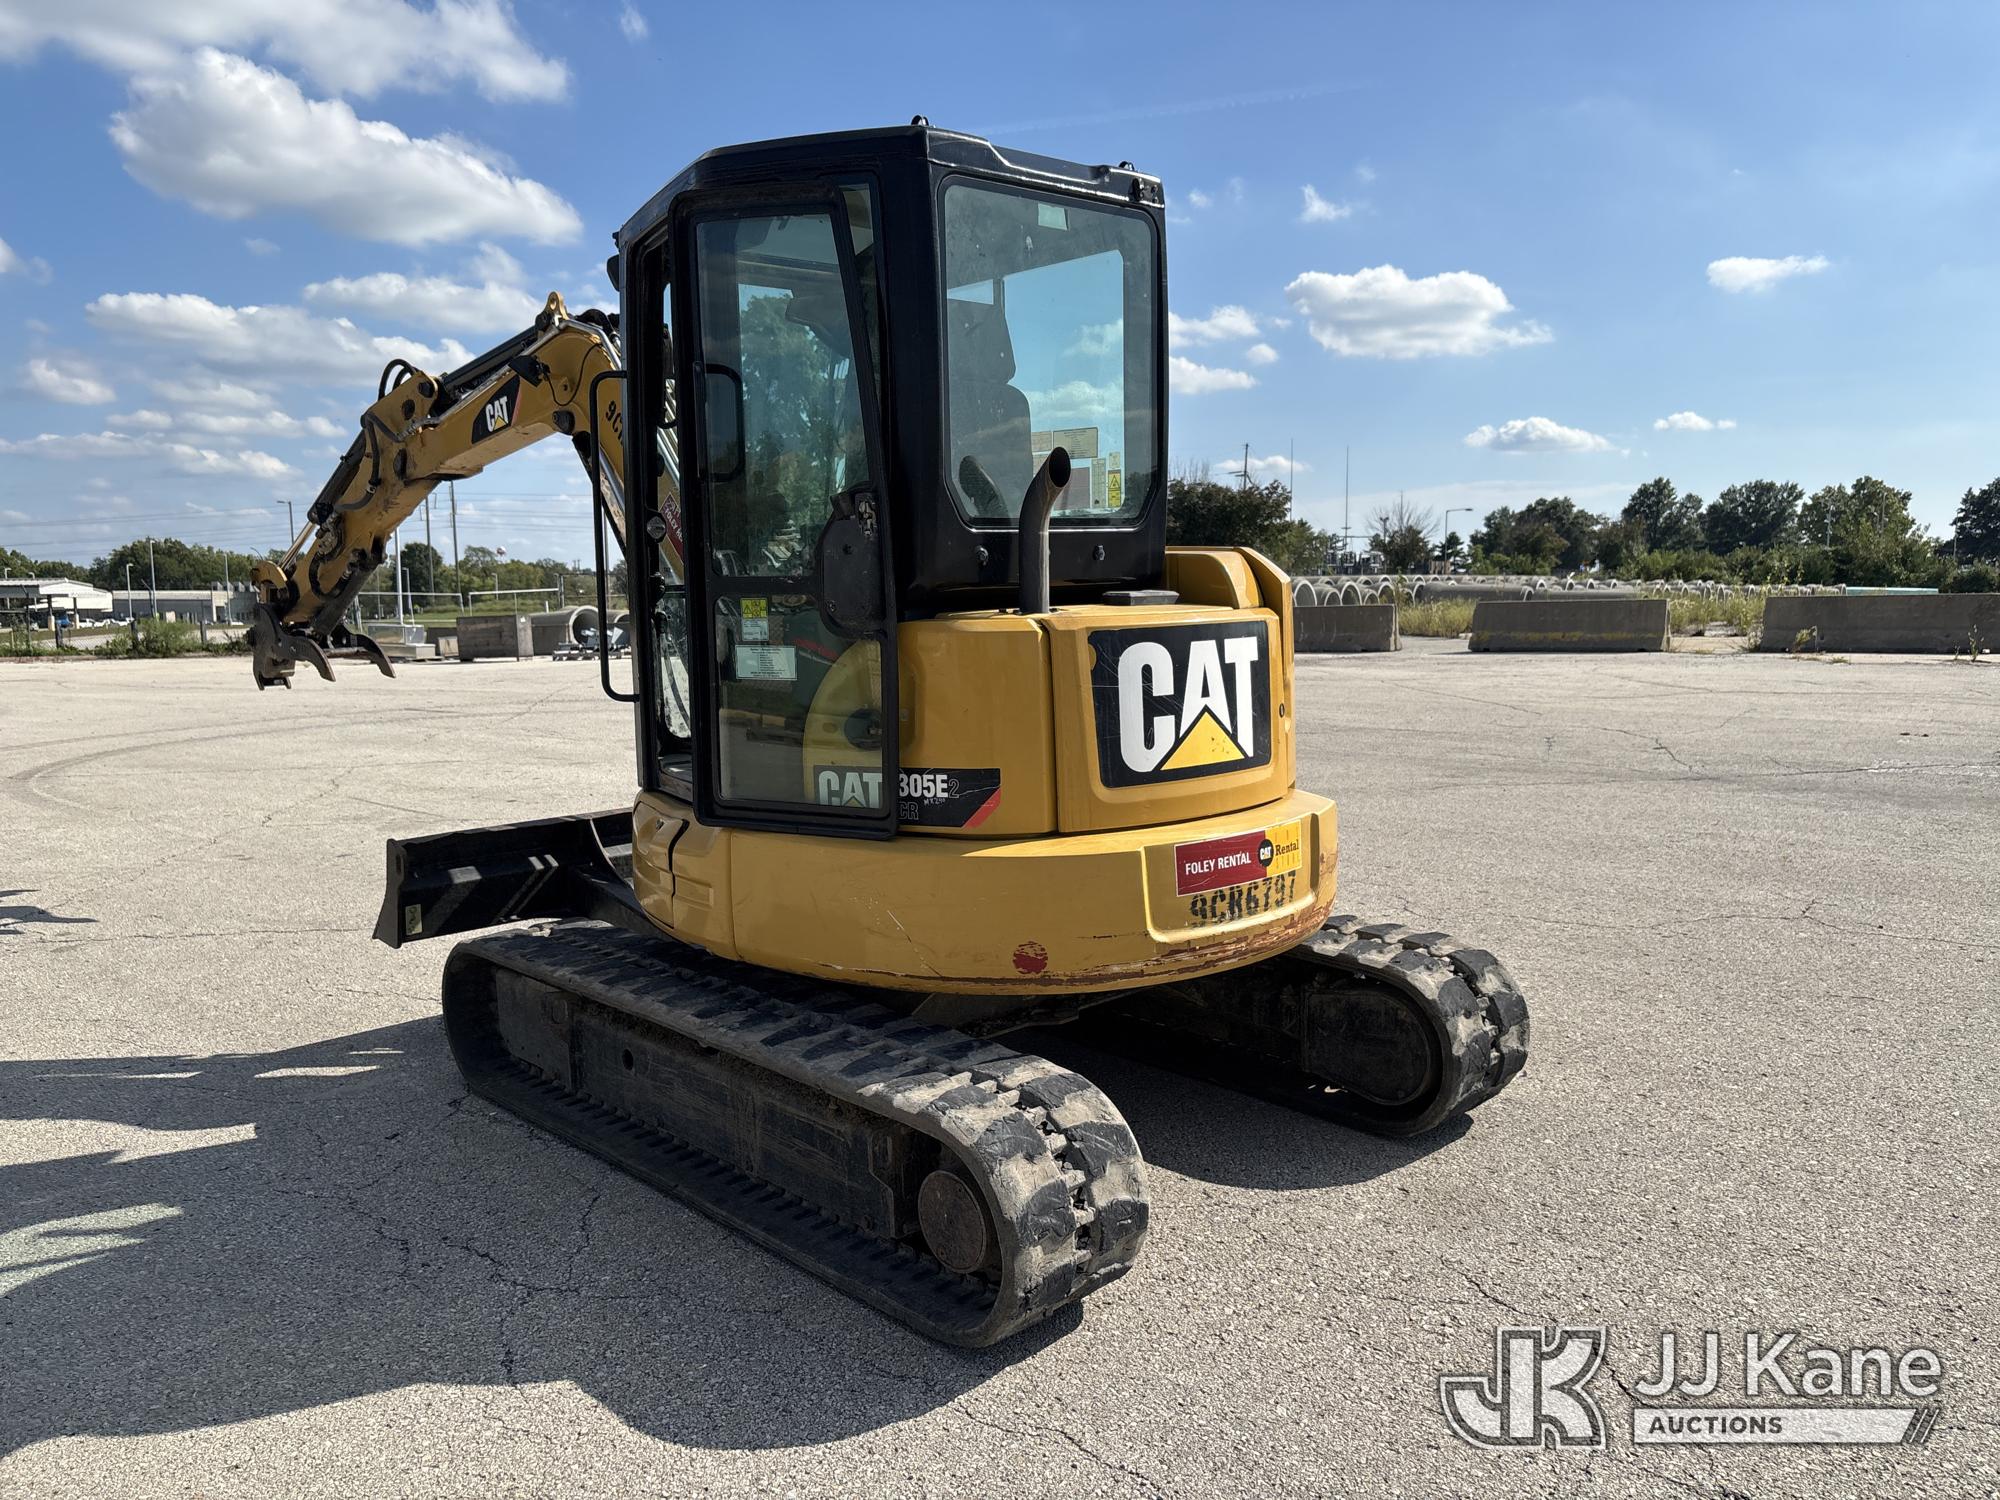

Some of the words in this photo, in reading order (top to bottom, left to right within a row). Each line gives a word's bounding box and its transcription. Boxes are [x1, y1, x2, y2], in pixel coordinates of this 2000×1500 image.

[485, 395, 509, 432] CAT
[1118, 636, 1259, 773] CAT
[818, 770, 883, 809] CAT
[1185, 857, 1215, 876] FOLEY
[1218, 851, 1252, 871] RENTAL
[1260, 846, 1272, 861] CAT
[1275, 839, 1300, 857] Rental
